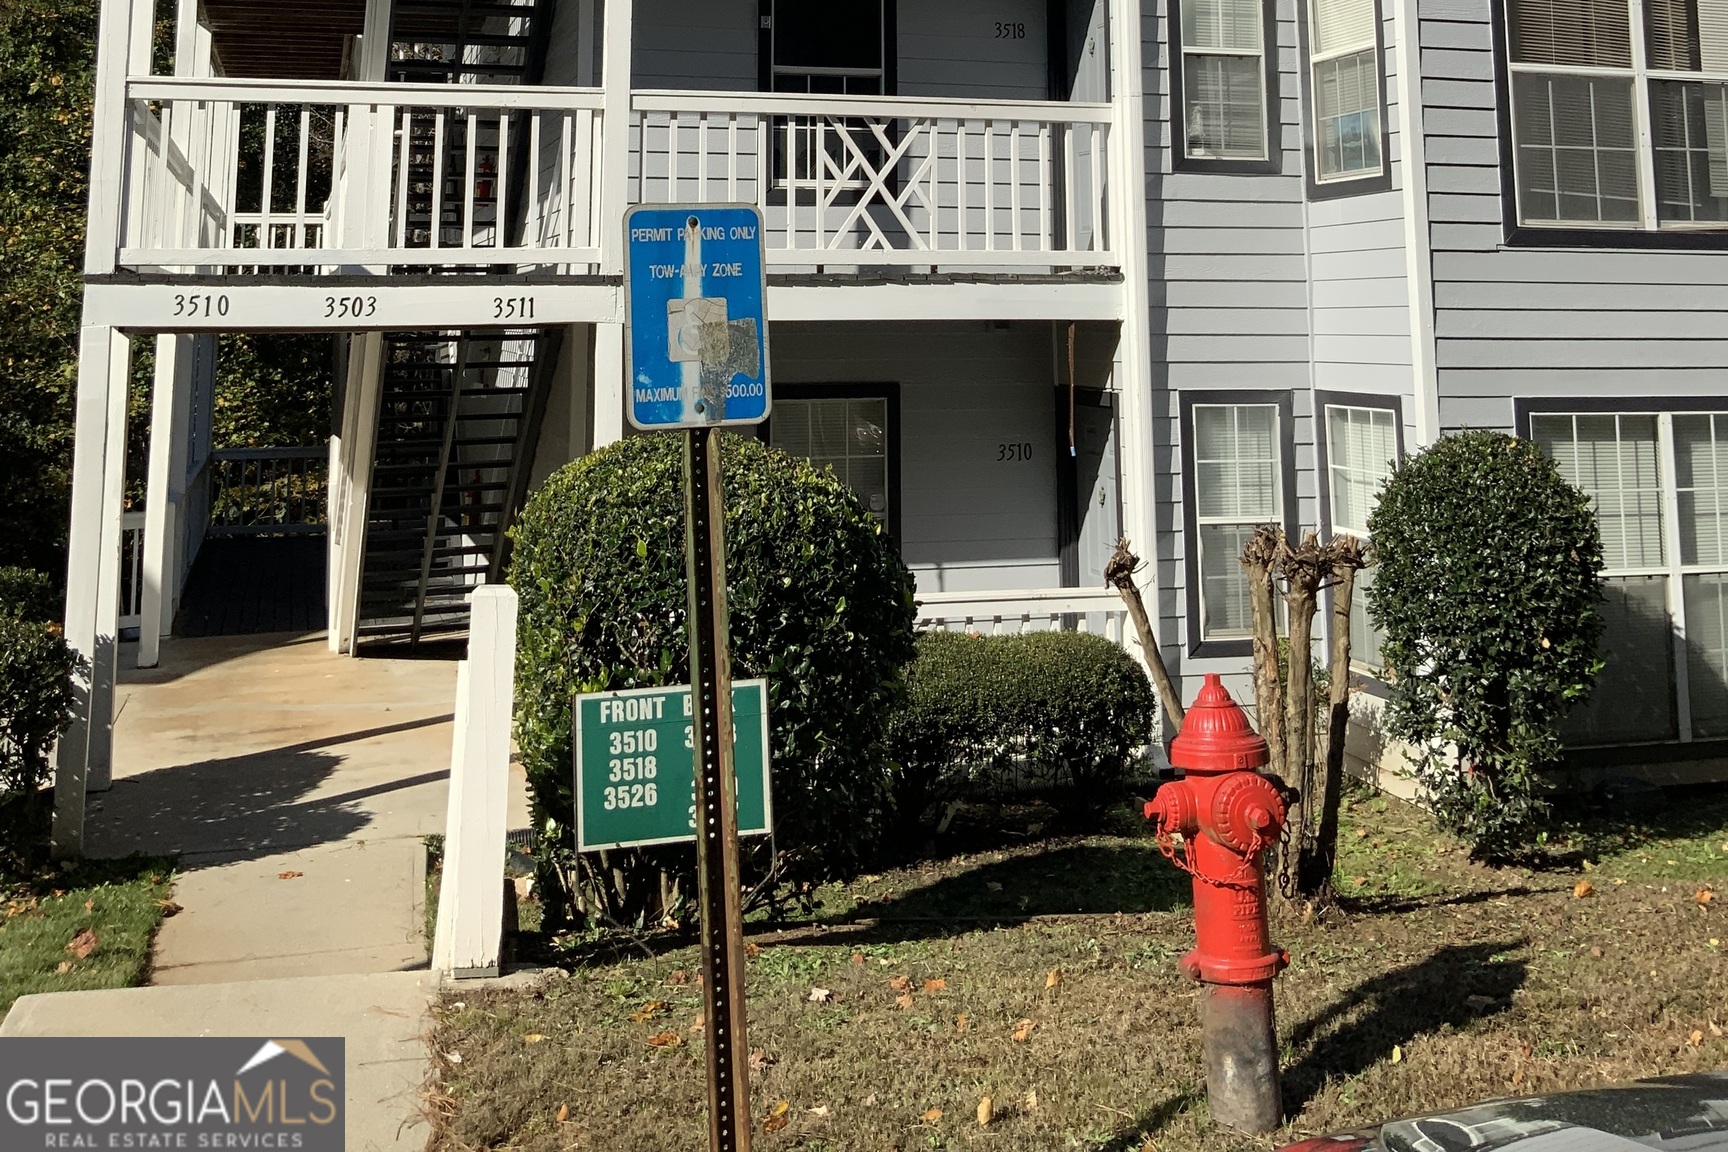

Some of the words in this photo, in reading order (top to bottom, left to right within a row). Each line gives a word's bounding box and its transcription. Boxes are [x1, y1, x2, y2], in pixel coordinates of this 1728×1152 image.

[994, 21, 1026, 40] 3518
[631, 227, 673, 243] PERMIT
[677, 226, 726, 242] PAKING
[730, 225, 756, 240] ONLY
[712, 262, 743, 278] ZONE
[173, 294, 230, 318] 3510
[324, 295, 377, 319] 3503
[493, 296, 535, 319] 3511
[721, 382, 764, 399] 500.00
[997, 442, 1032, 462] 3510
[600, 696, 666, 724] FRONT
[609, 728, 658, 755] 3510
[608, 755, 657, 782] 3518
[603, 782, 658, 810] 3526
